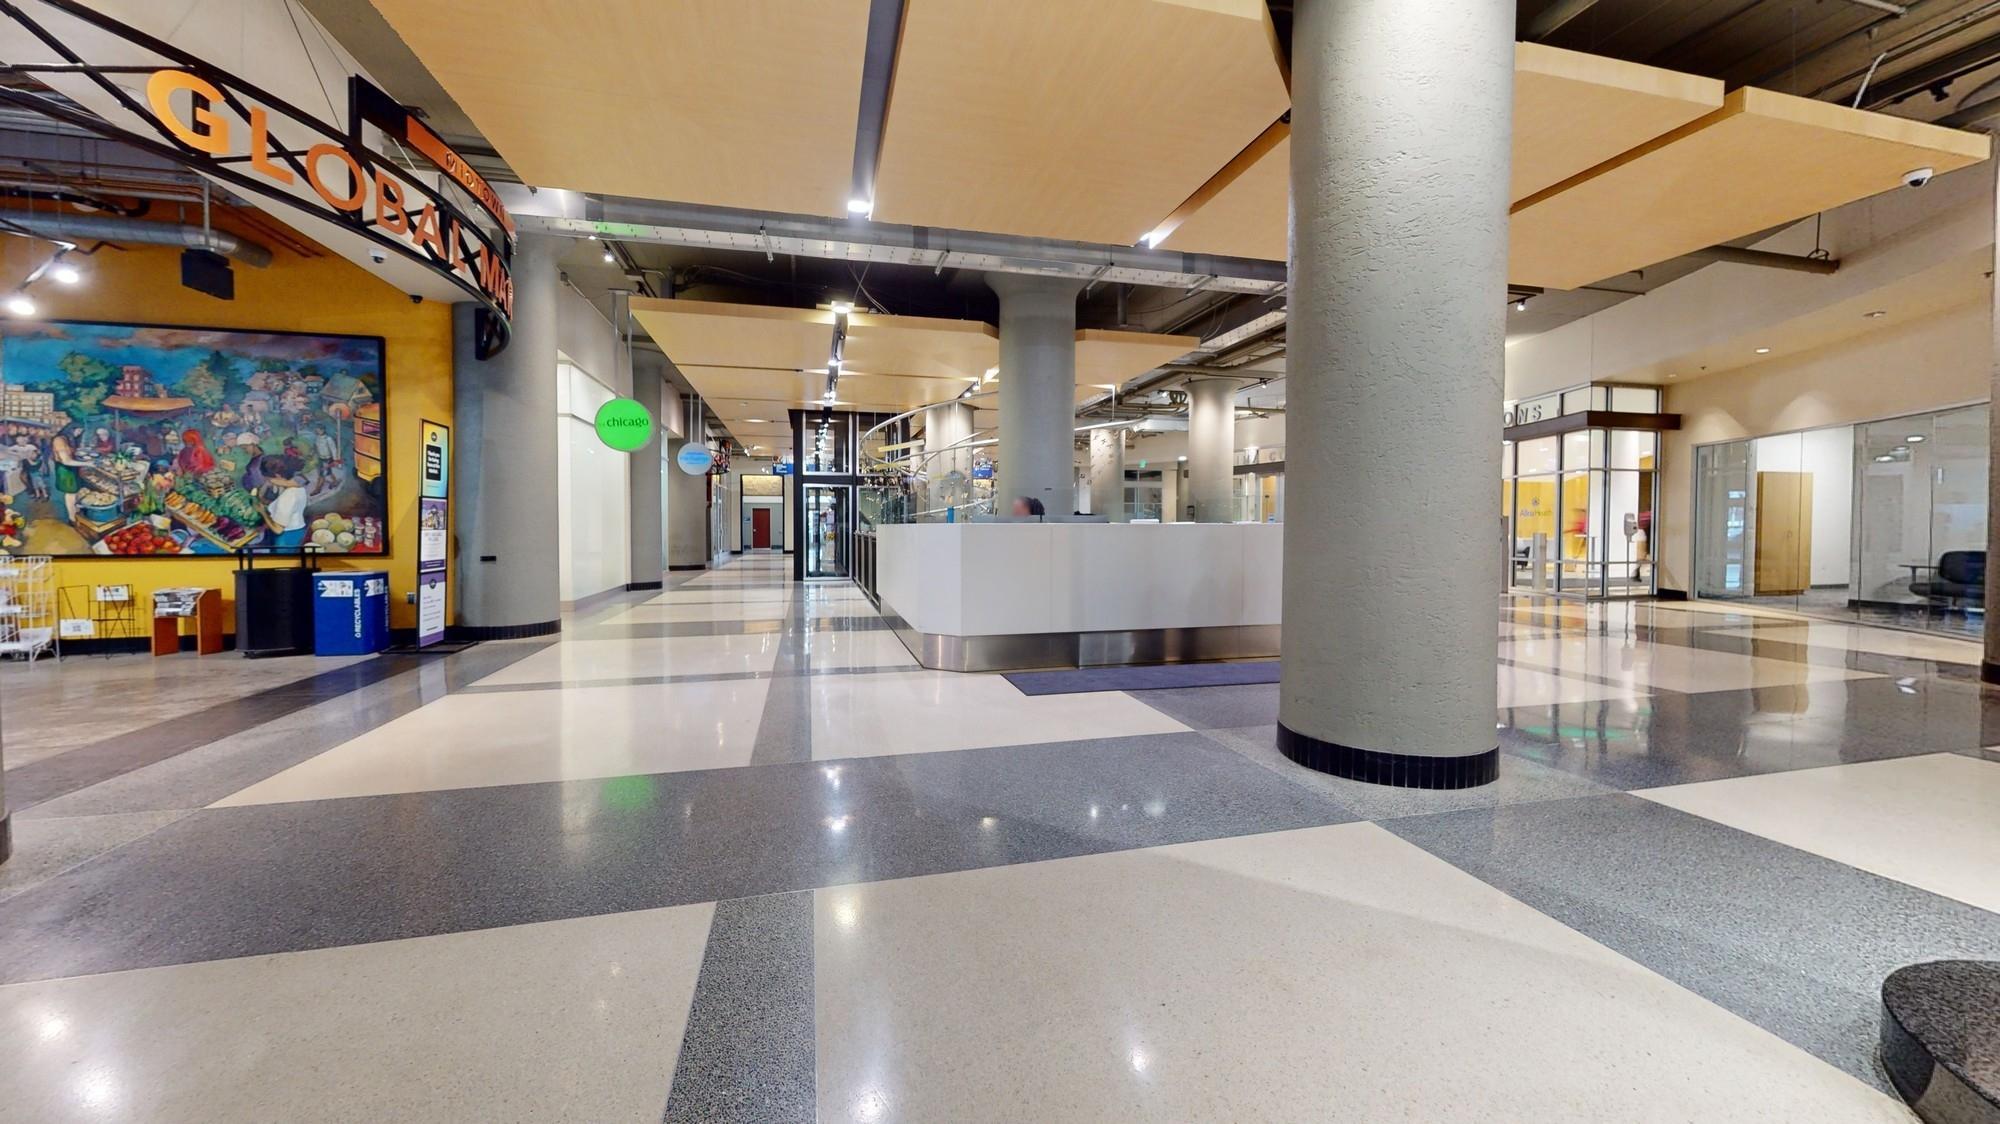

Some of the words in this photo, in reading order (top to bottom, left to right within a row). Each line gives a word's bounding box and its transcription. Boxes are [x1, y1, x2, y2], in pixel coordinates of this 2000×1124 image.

[147, 69, 467, 273] GLOBAL
[606, 417, 649, 428] chicago
[354, 588, 362, 633] RECYCLABLES
